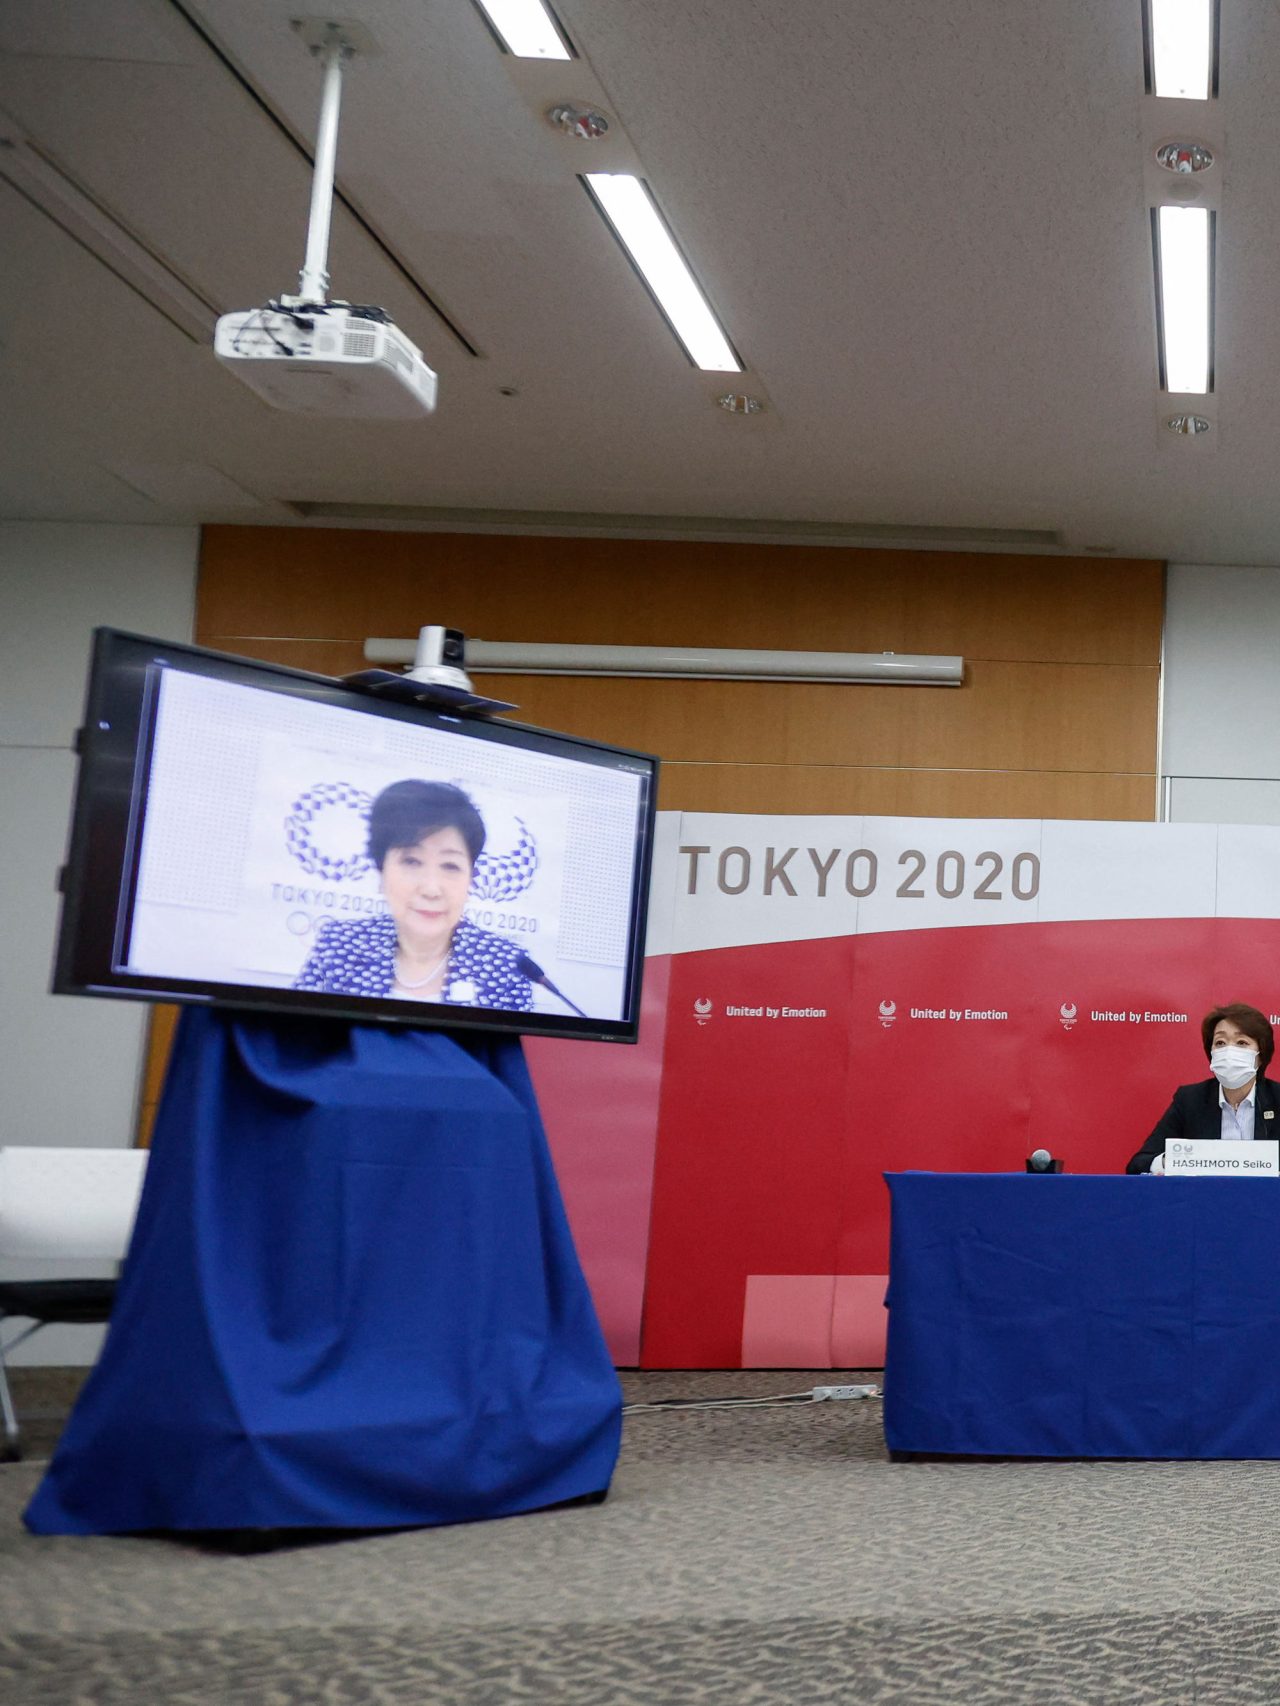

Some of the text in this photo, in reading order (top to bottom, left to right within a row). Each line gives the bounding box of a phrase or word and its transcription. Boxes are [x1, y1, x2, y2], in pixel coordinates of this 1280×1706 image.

[679, 845, 1041, 901] TOKYO 2020
[726, 1006, 827, 1019] United by Emotion
[910, 1008, 1008, 1021] United by Emotion
[1091, 1010, 1126, 1022] United
[1129, 1011, 1141, 1024] by
[1144, 1011, 1188, 1023] Emotion
[1172, 1159, 1272, 1169] HASHIMOTO Seiko
